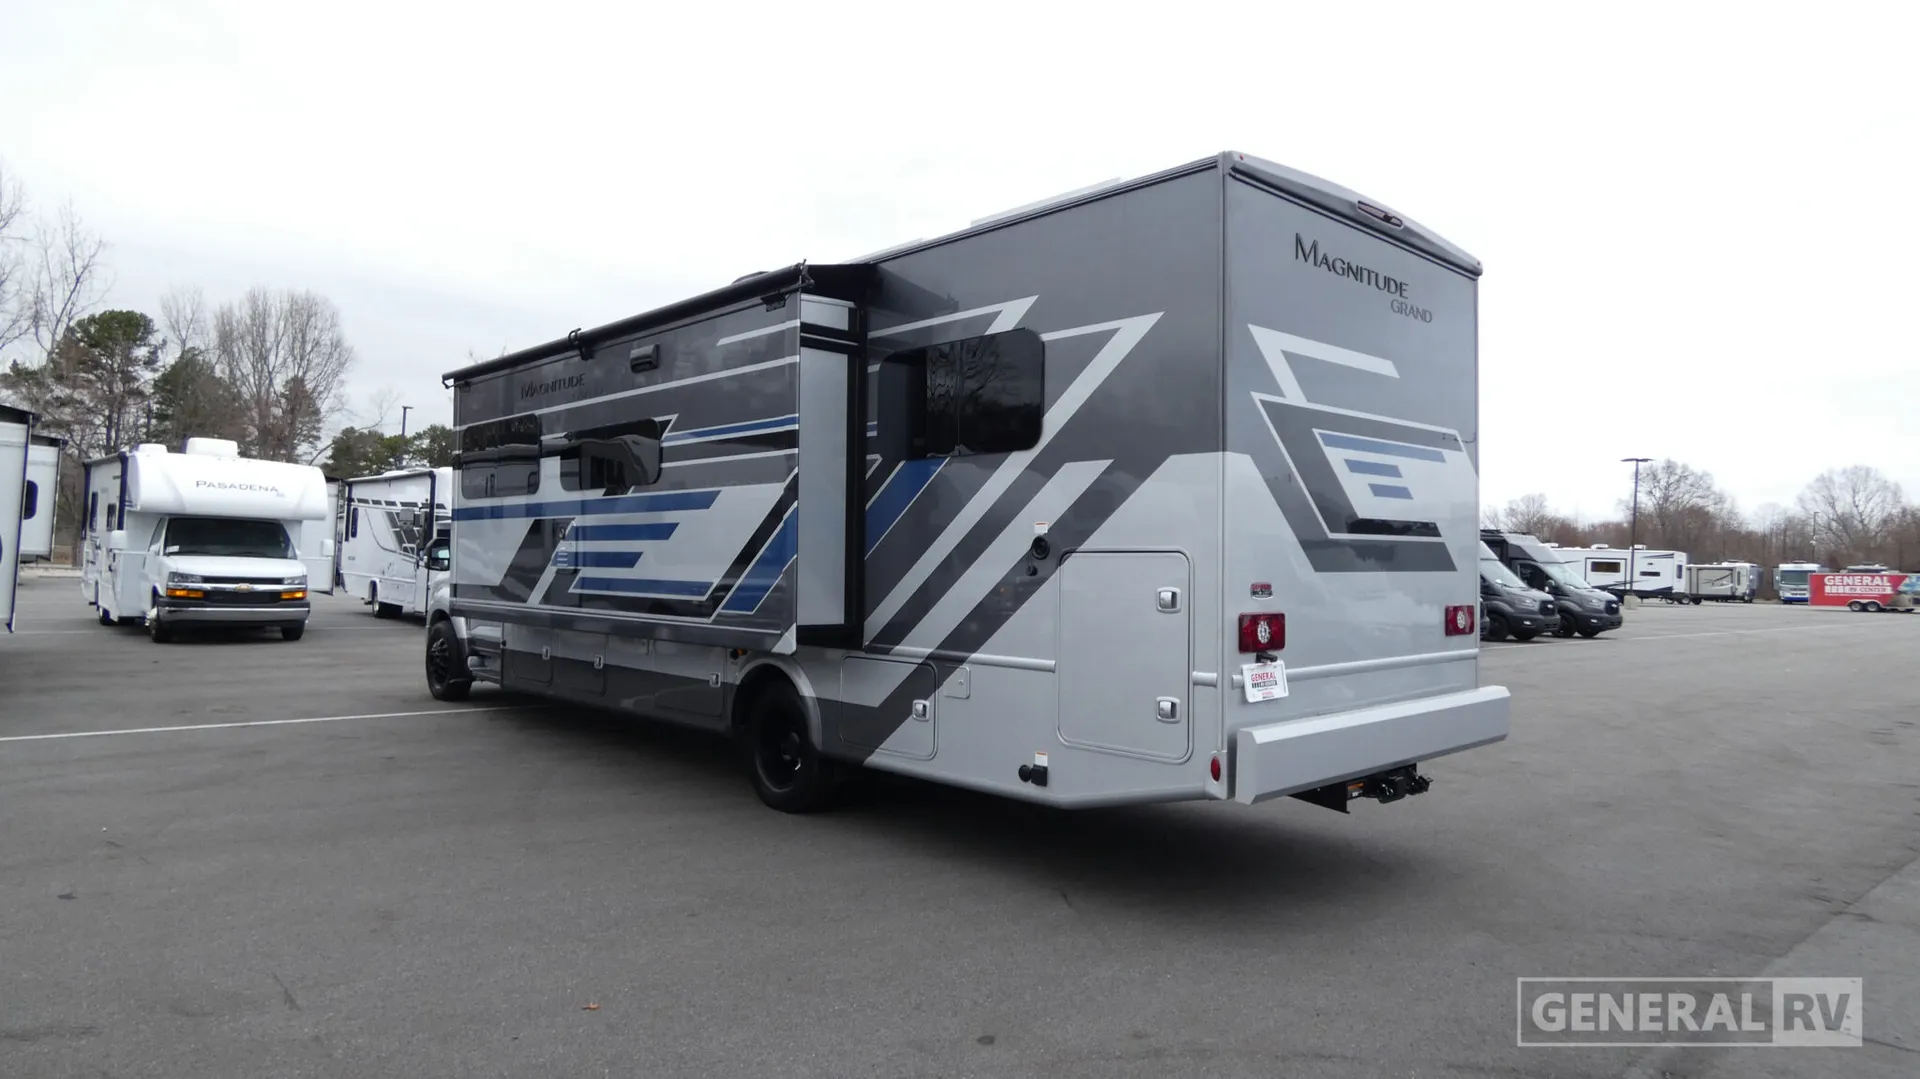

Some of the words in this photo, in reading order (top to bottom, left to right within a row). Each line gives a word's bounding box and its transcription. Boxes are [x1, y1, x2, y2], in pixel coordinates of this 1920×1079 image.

[1295, 232, 1409, 300] MAGNITUDE
[1390, 299, 1433, 324] GRAND
[520, 372, 586, 400] MAGNITUDE
[195, 480, 279, 492] PASADENA
[1823, 575, 1891, 586] GENERAL
[1251, 671, 1277, 682] GENERAL
